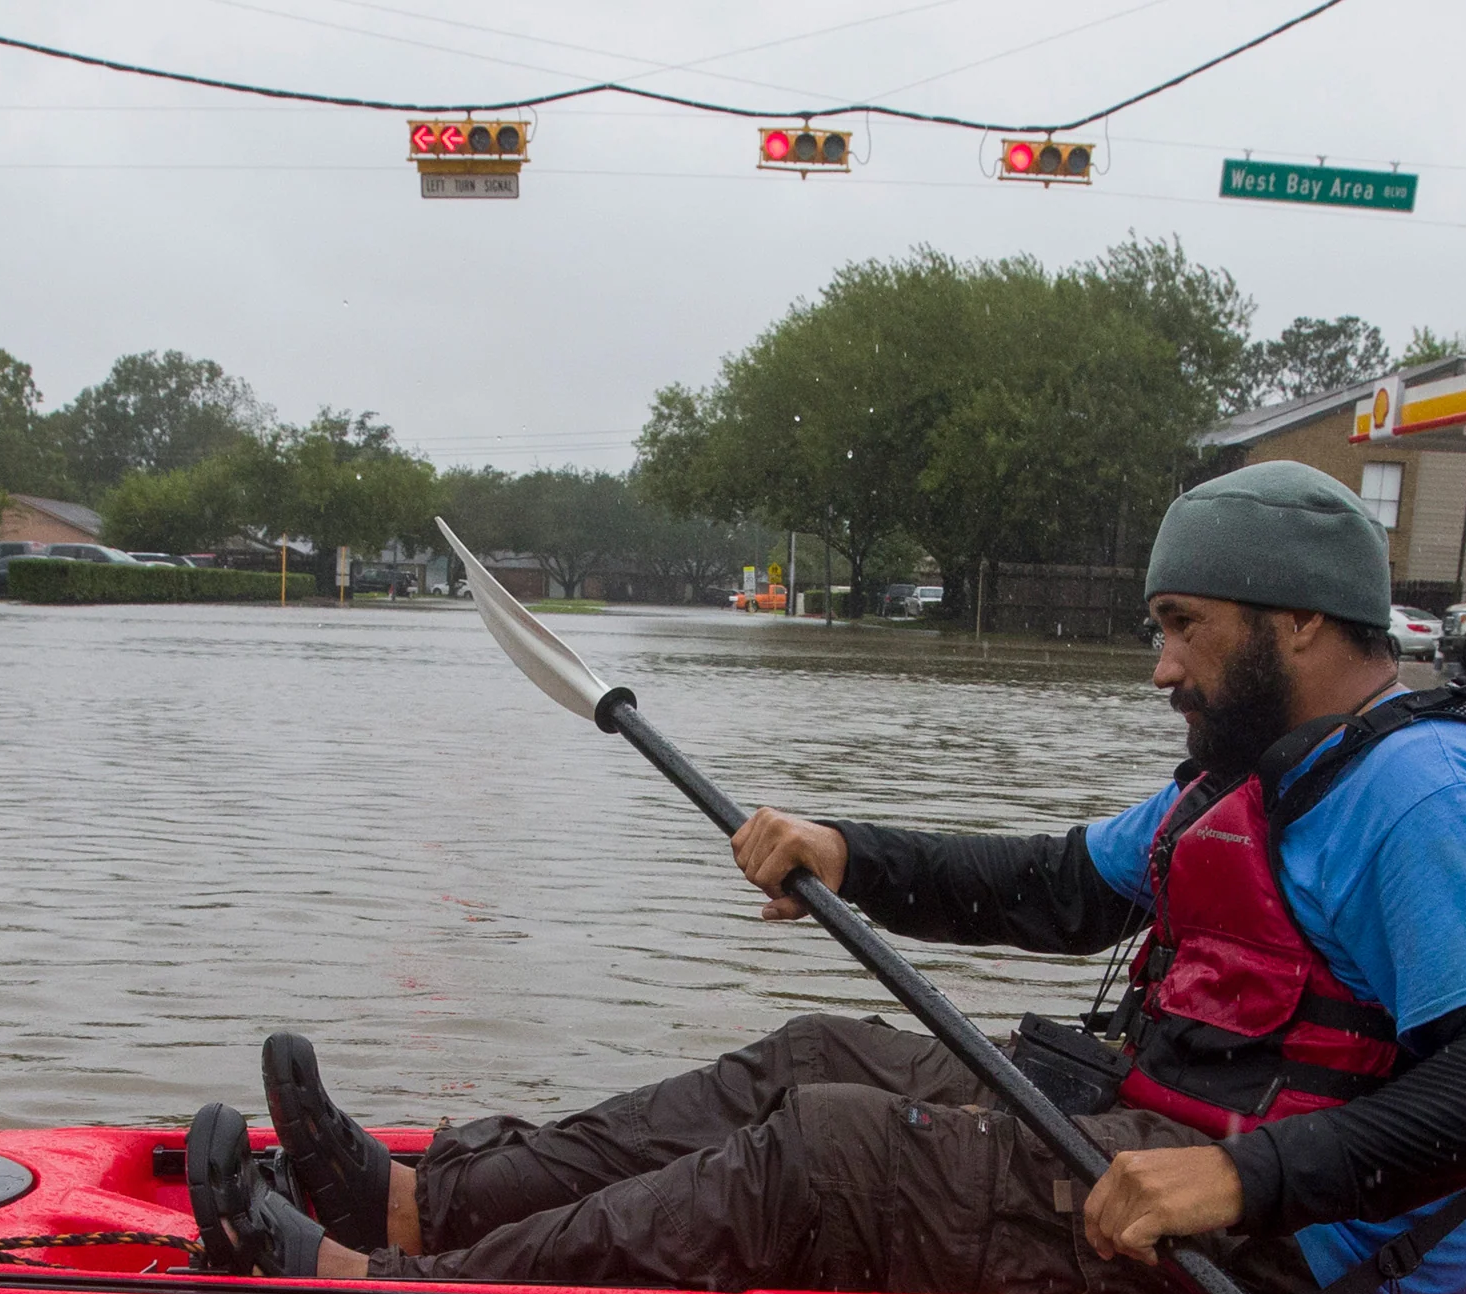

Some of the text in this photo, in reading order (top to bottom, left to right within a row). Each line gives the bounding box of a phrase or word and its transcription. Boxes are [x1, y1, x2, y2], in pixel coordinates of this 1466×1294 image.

[426, 179, 514, 193] LEFT TURN SIGNAL
[1230, 168, 1408, 200] West Bay Area BLVD
